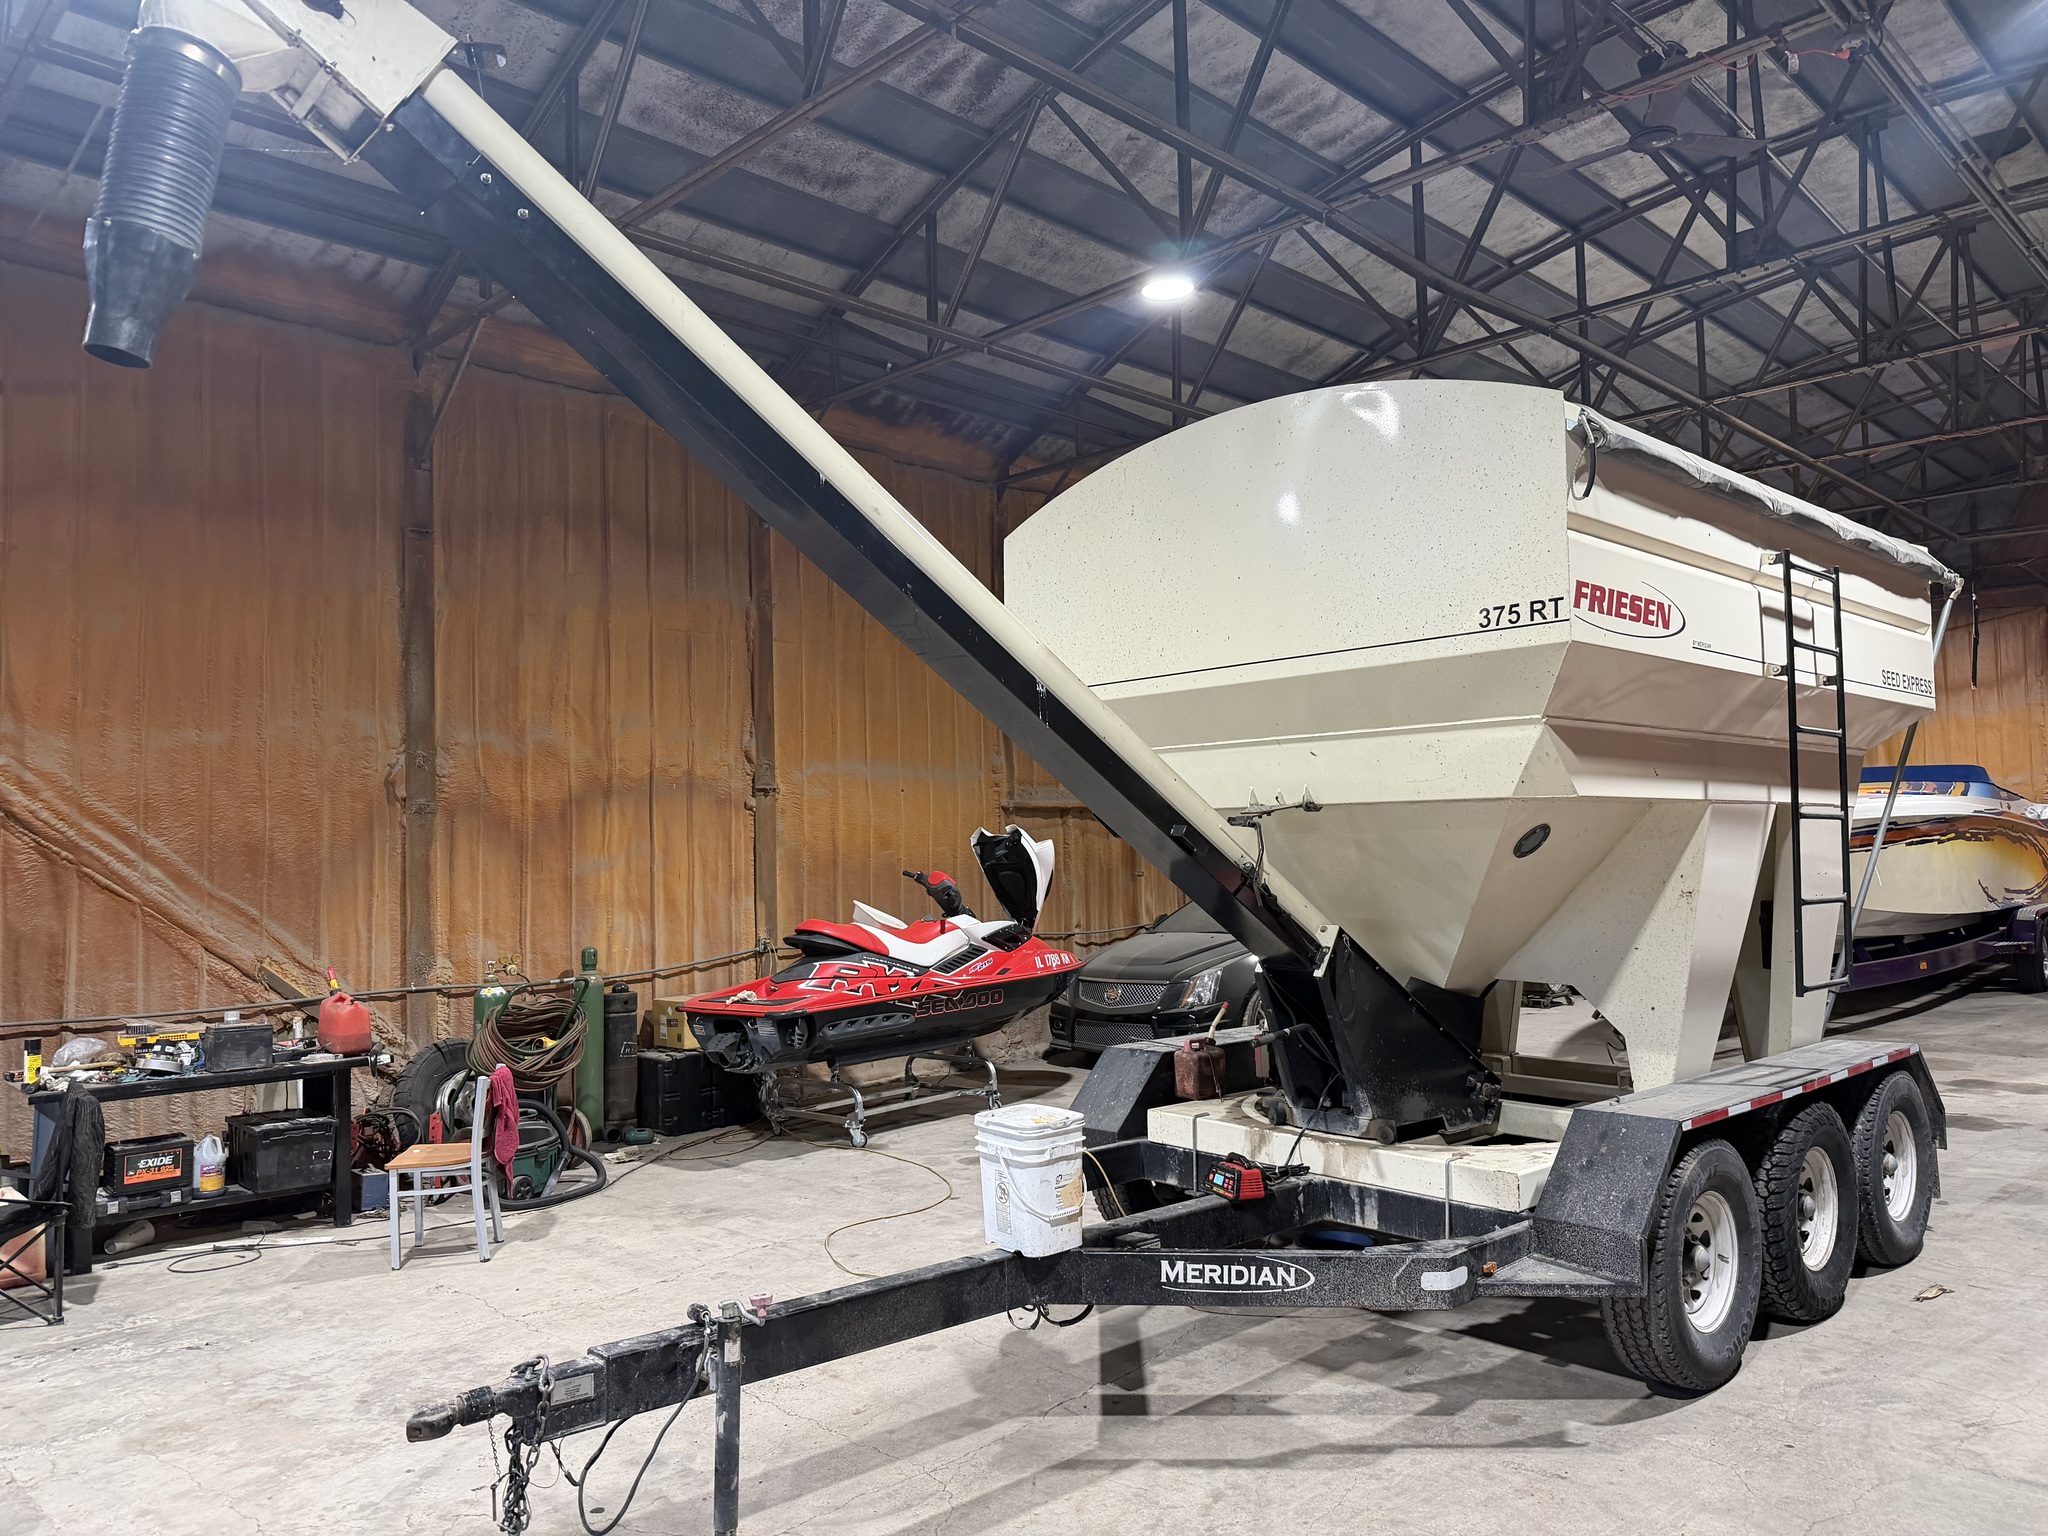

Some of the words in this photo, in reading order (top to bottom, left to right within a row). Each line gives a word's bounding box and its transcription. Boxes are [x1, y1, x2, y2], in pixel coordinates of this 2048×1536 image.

[1478, 603, 1521, 628] 375
[1530, 596, 1564, 622] RT
[1573, 579, 1672, 630] FRIESEN
[1881, 669, 1900, 688] SEED
[1902, 674, 1932, 694] EXPRESS
[138, 1155, 175, 1168] EXIDE
[1160, 1260, 1296, 1286] MERIDIAN
